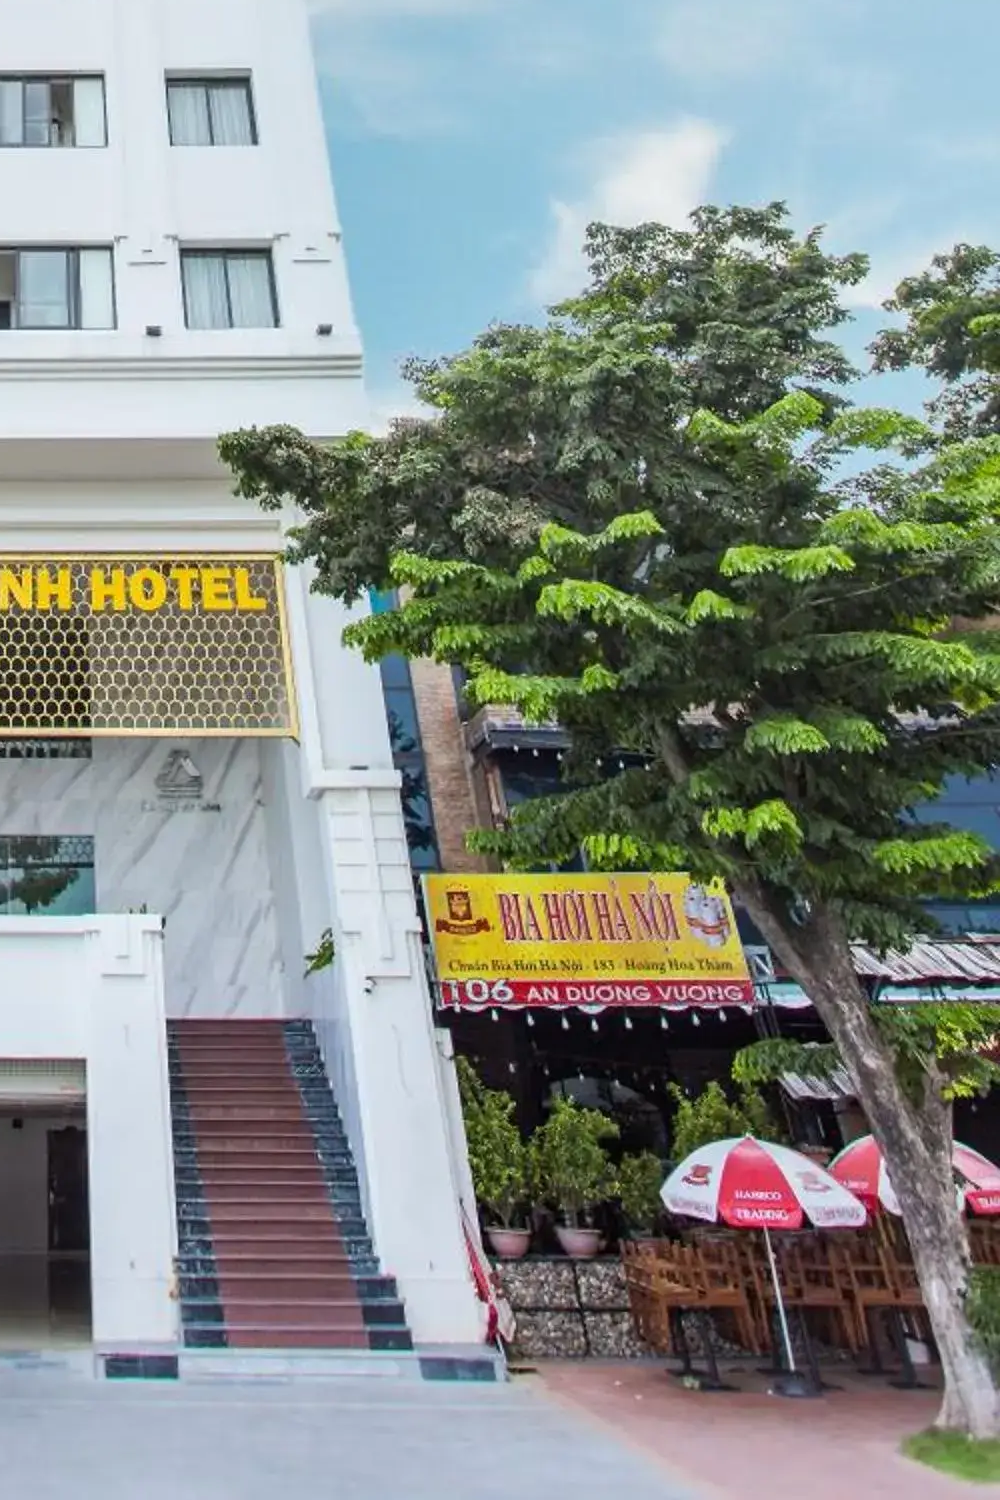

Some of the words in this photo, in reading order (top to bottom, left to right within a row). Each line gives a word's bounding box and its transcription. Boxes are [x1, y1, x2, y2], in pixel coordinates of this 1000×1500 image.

[91, 568, 267, 613] HOTEL
[497, 892, 544, 941] BIA
[443, 979, 514, 1003] 106
[526, 984, 560, 1001] AN
